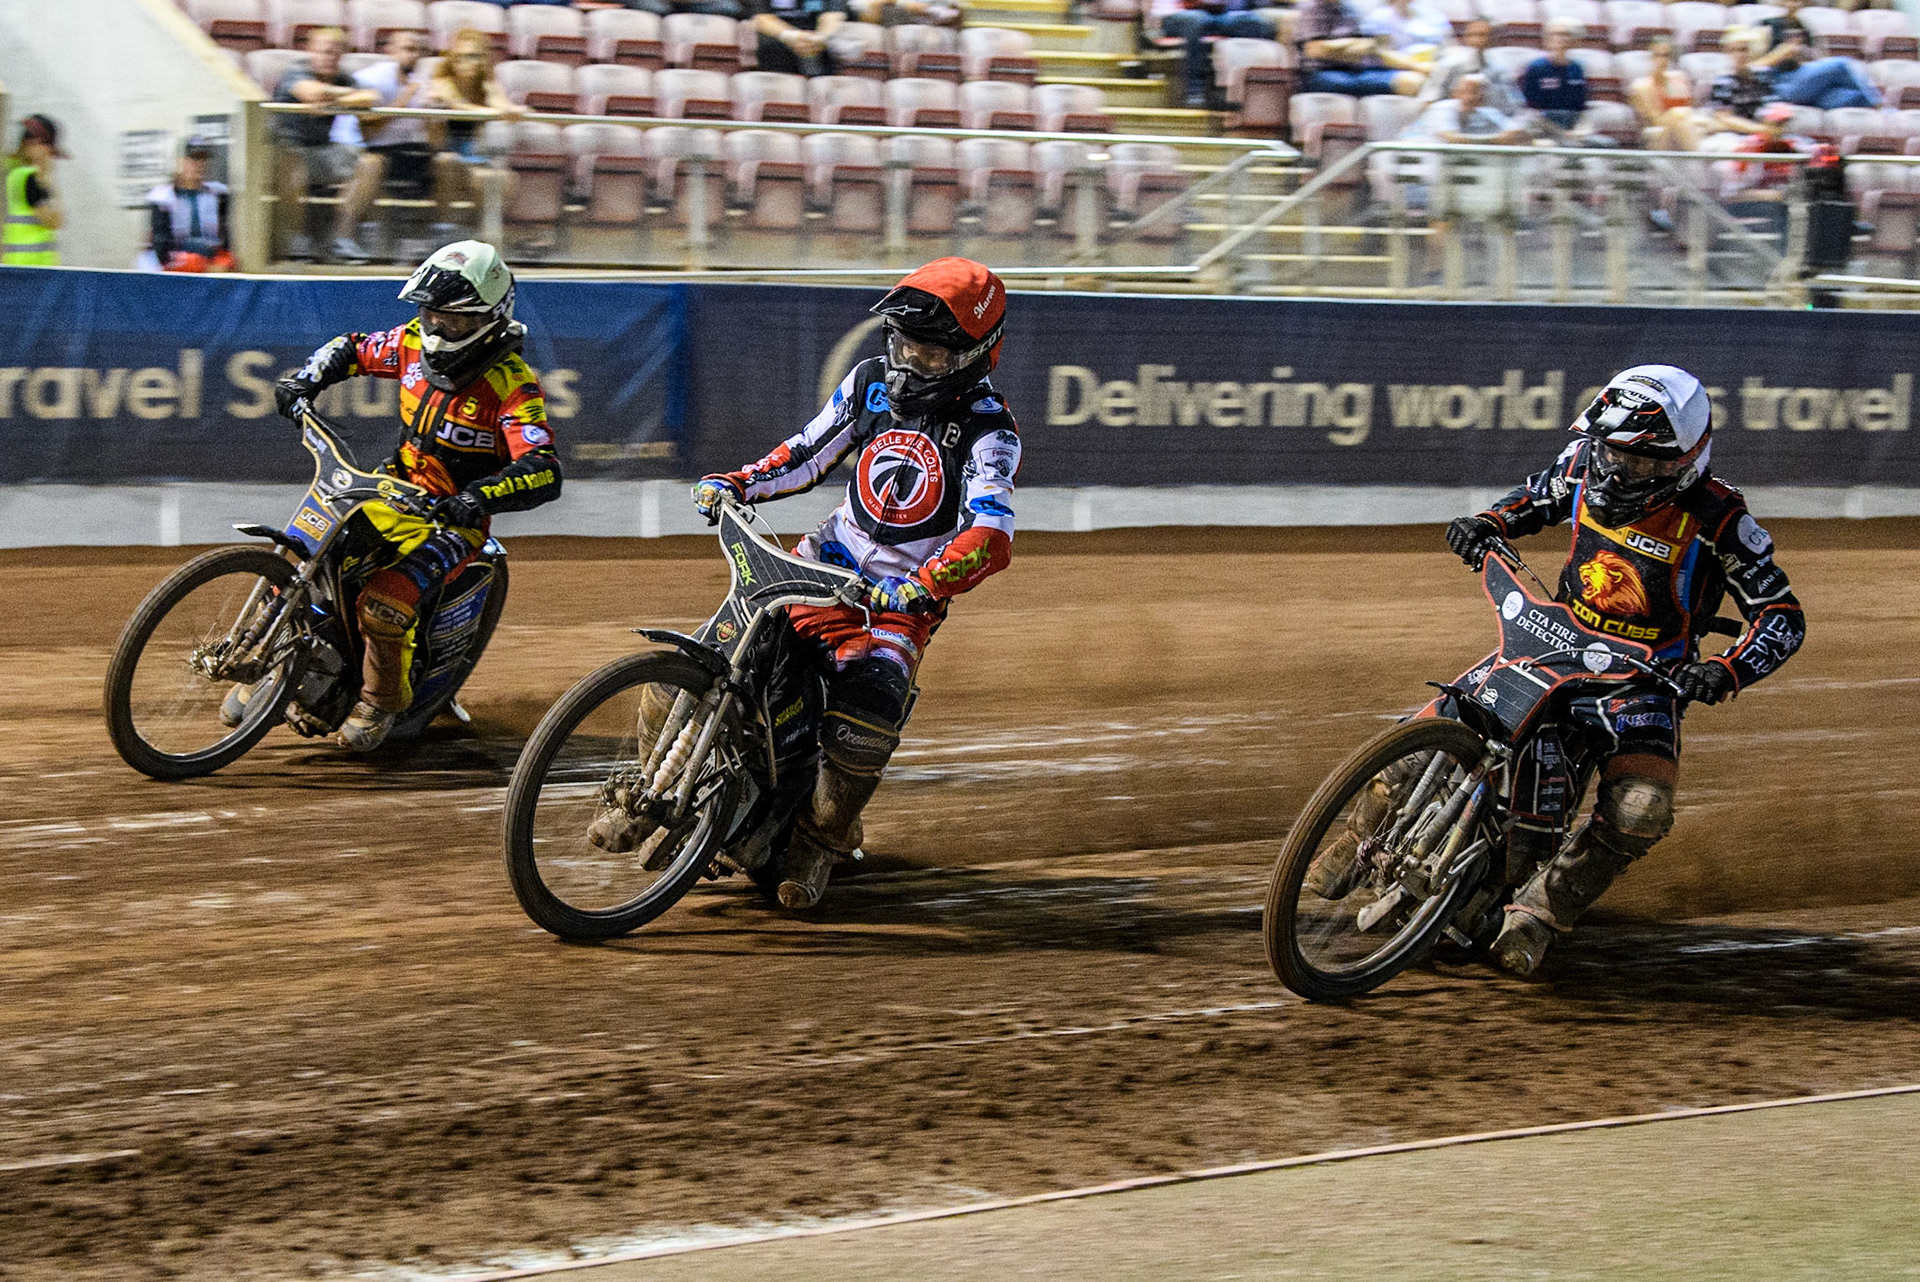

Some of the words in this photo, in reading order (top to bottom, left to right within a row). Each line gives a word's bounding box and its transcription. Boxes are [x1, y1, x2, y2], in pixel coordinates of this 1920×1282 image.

[462, 396, 479, 416] 5
[1047, 363, 1374, 446] Delivering
[1386, 368, 1566, 430] world
[1738, 372, 1914, 432] travel
[436, 421, 495, 449] JCB
[870, 435, 902, 454] BELLE
[905, 436, 926, 451] VUE
[923, 449, 939, 483] COLTS
[300, 510, 328, 531] JCB
[867, 498, 908, 519] MANCESTER
[1676, 511, 1690, 539] 1
[930, 537, 992, 587] FORK
[1626, 532, 1671, 558] JCB
[731, 543, 757, 586] FORK
[1516, 615, 1580, 659] DETECTION
[1528, 609, 1551, 628] CTA
[1549, 620, 1578, 644] FIRE
[1571, 598, 1601, 628] ION
[1603, 619, 1661, 640] CUBS
